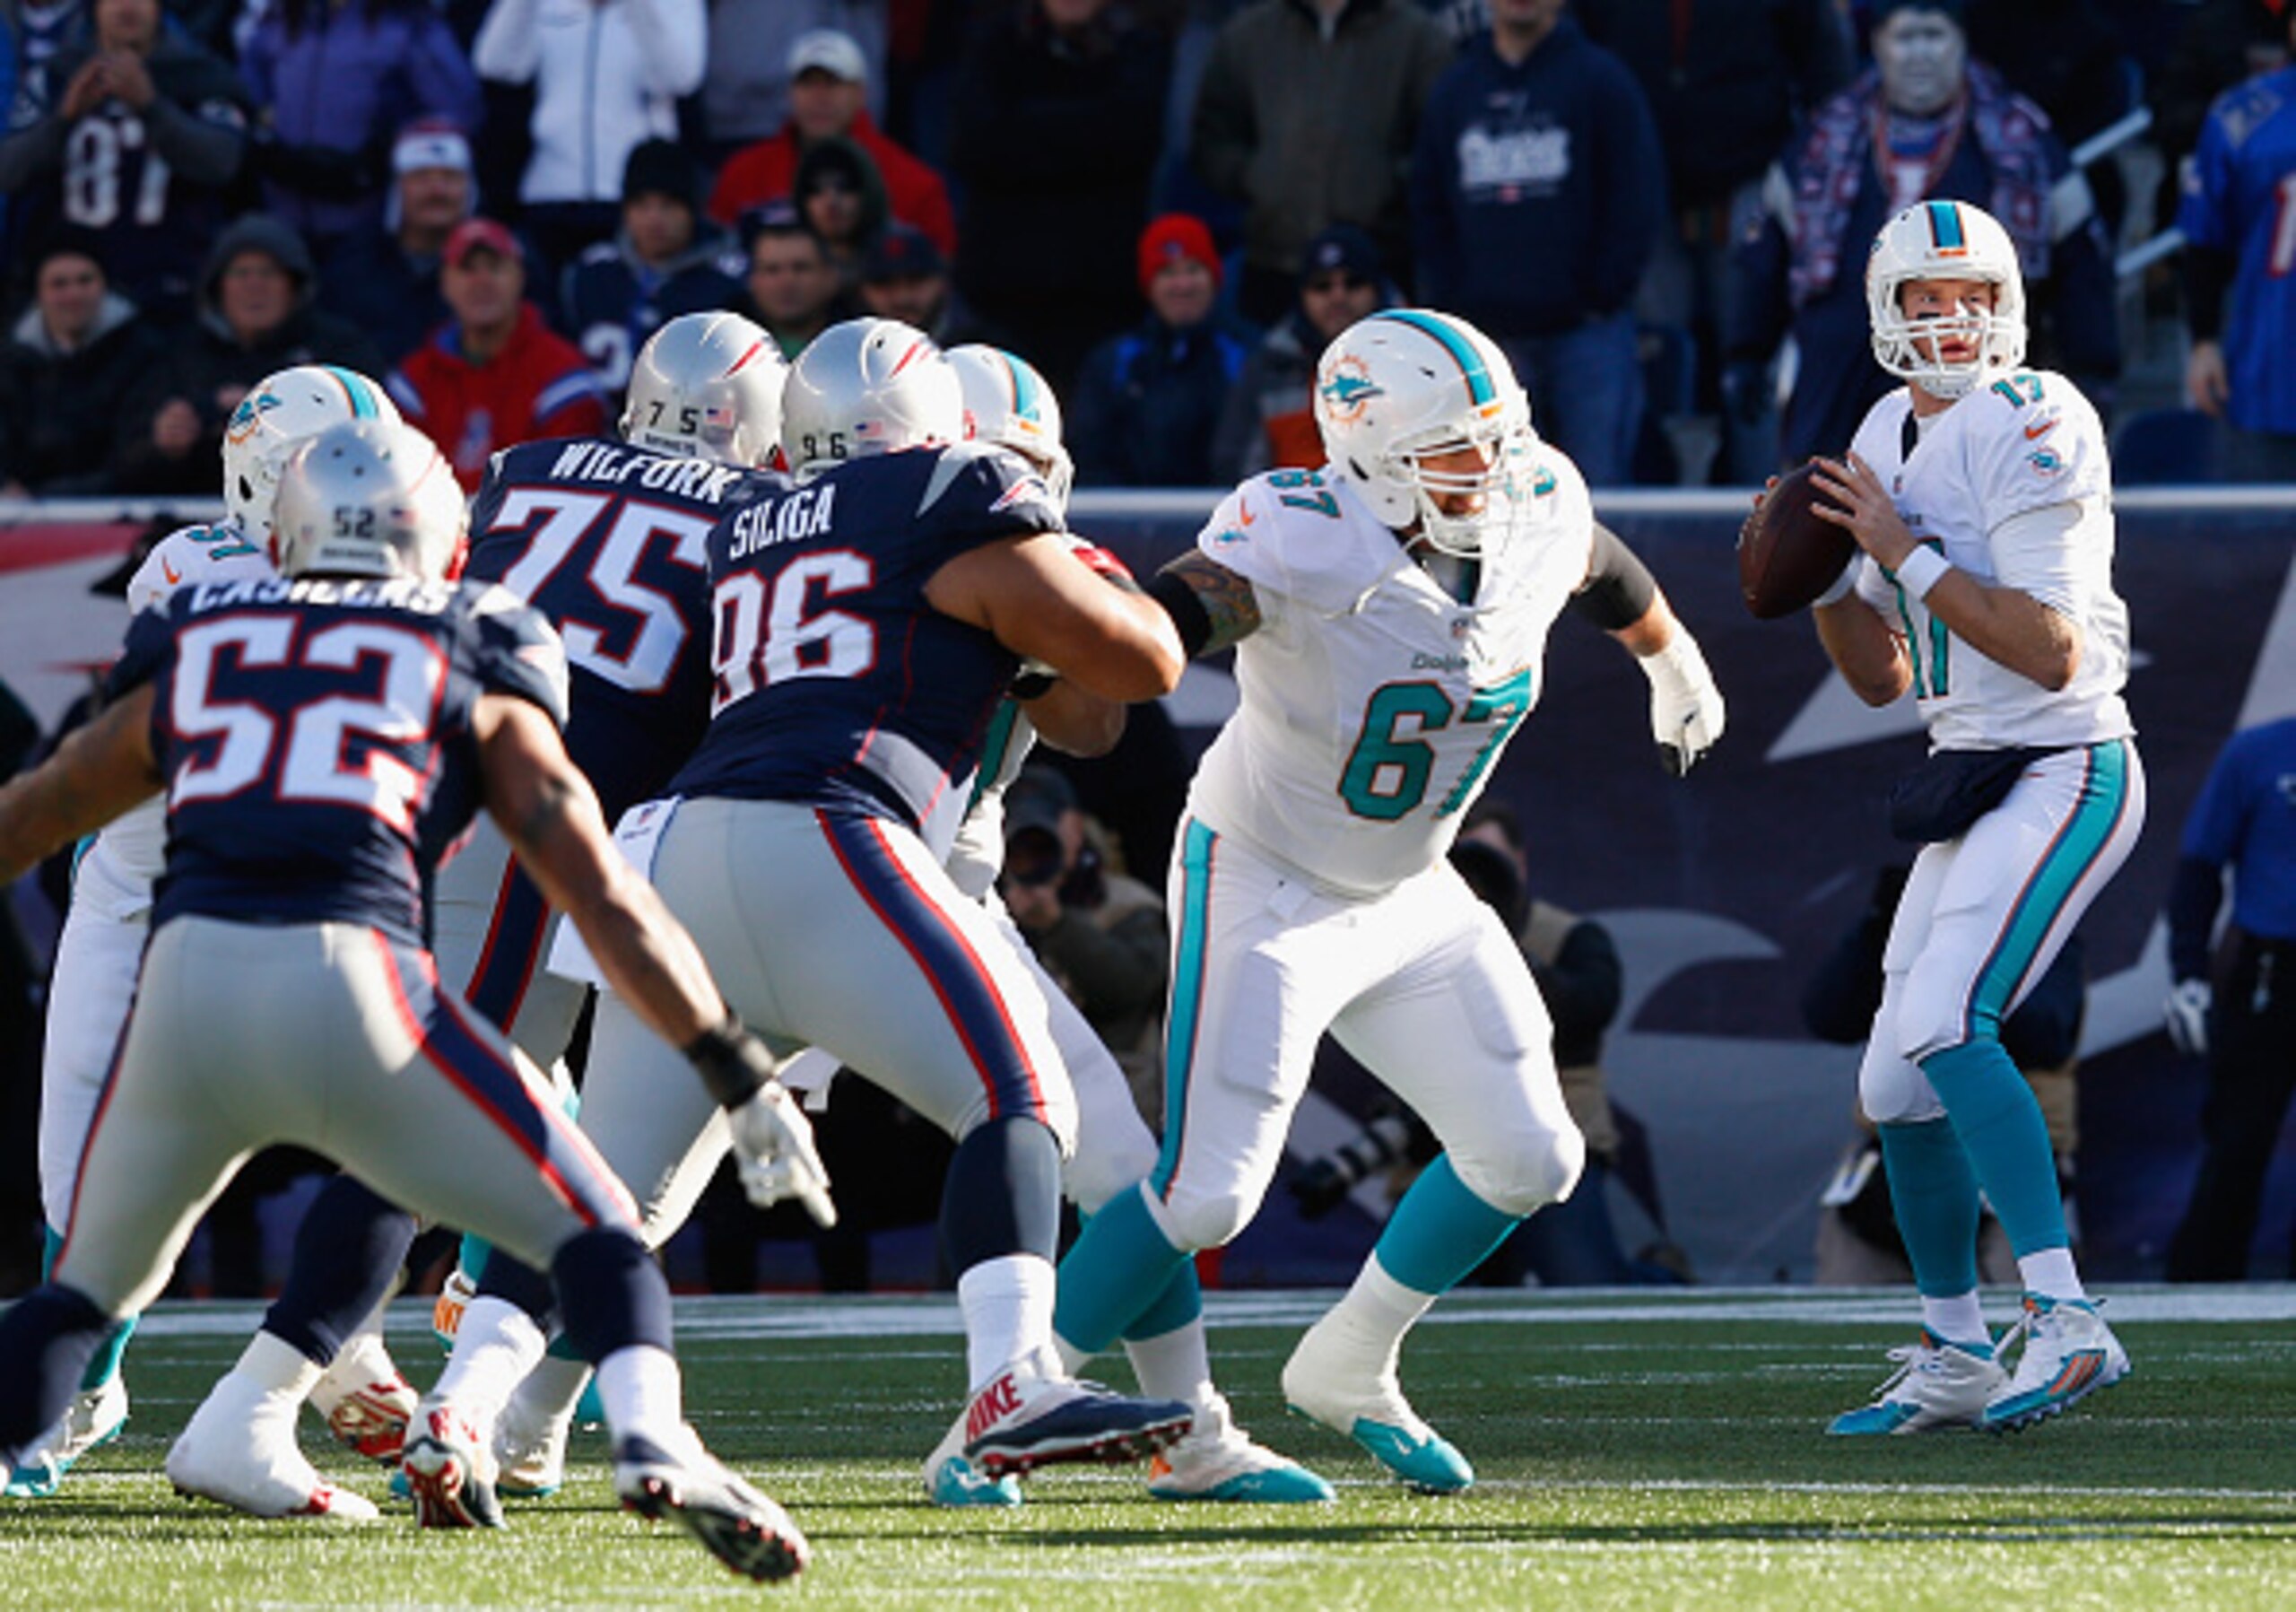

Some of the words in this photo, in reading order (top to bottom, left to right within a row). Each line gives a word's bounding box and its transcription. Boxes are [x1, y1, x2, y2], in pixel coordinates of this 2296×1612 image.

[649, 401, 700, 433] 75
[803, 432, 848, 460] 96
[551, 443, 743, 504] WILFORK
[333, 506, 375, 540] 52
[729, 484, 836, 561] SILIGA
[486, 483, 721, 696] 75
[710, 545, 880, 721] 96
[169, 614, 448, 834] 52
[1336, 664, 1532, 823] 67
[966, 1372, 1024, 1445] NIKE
